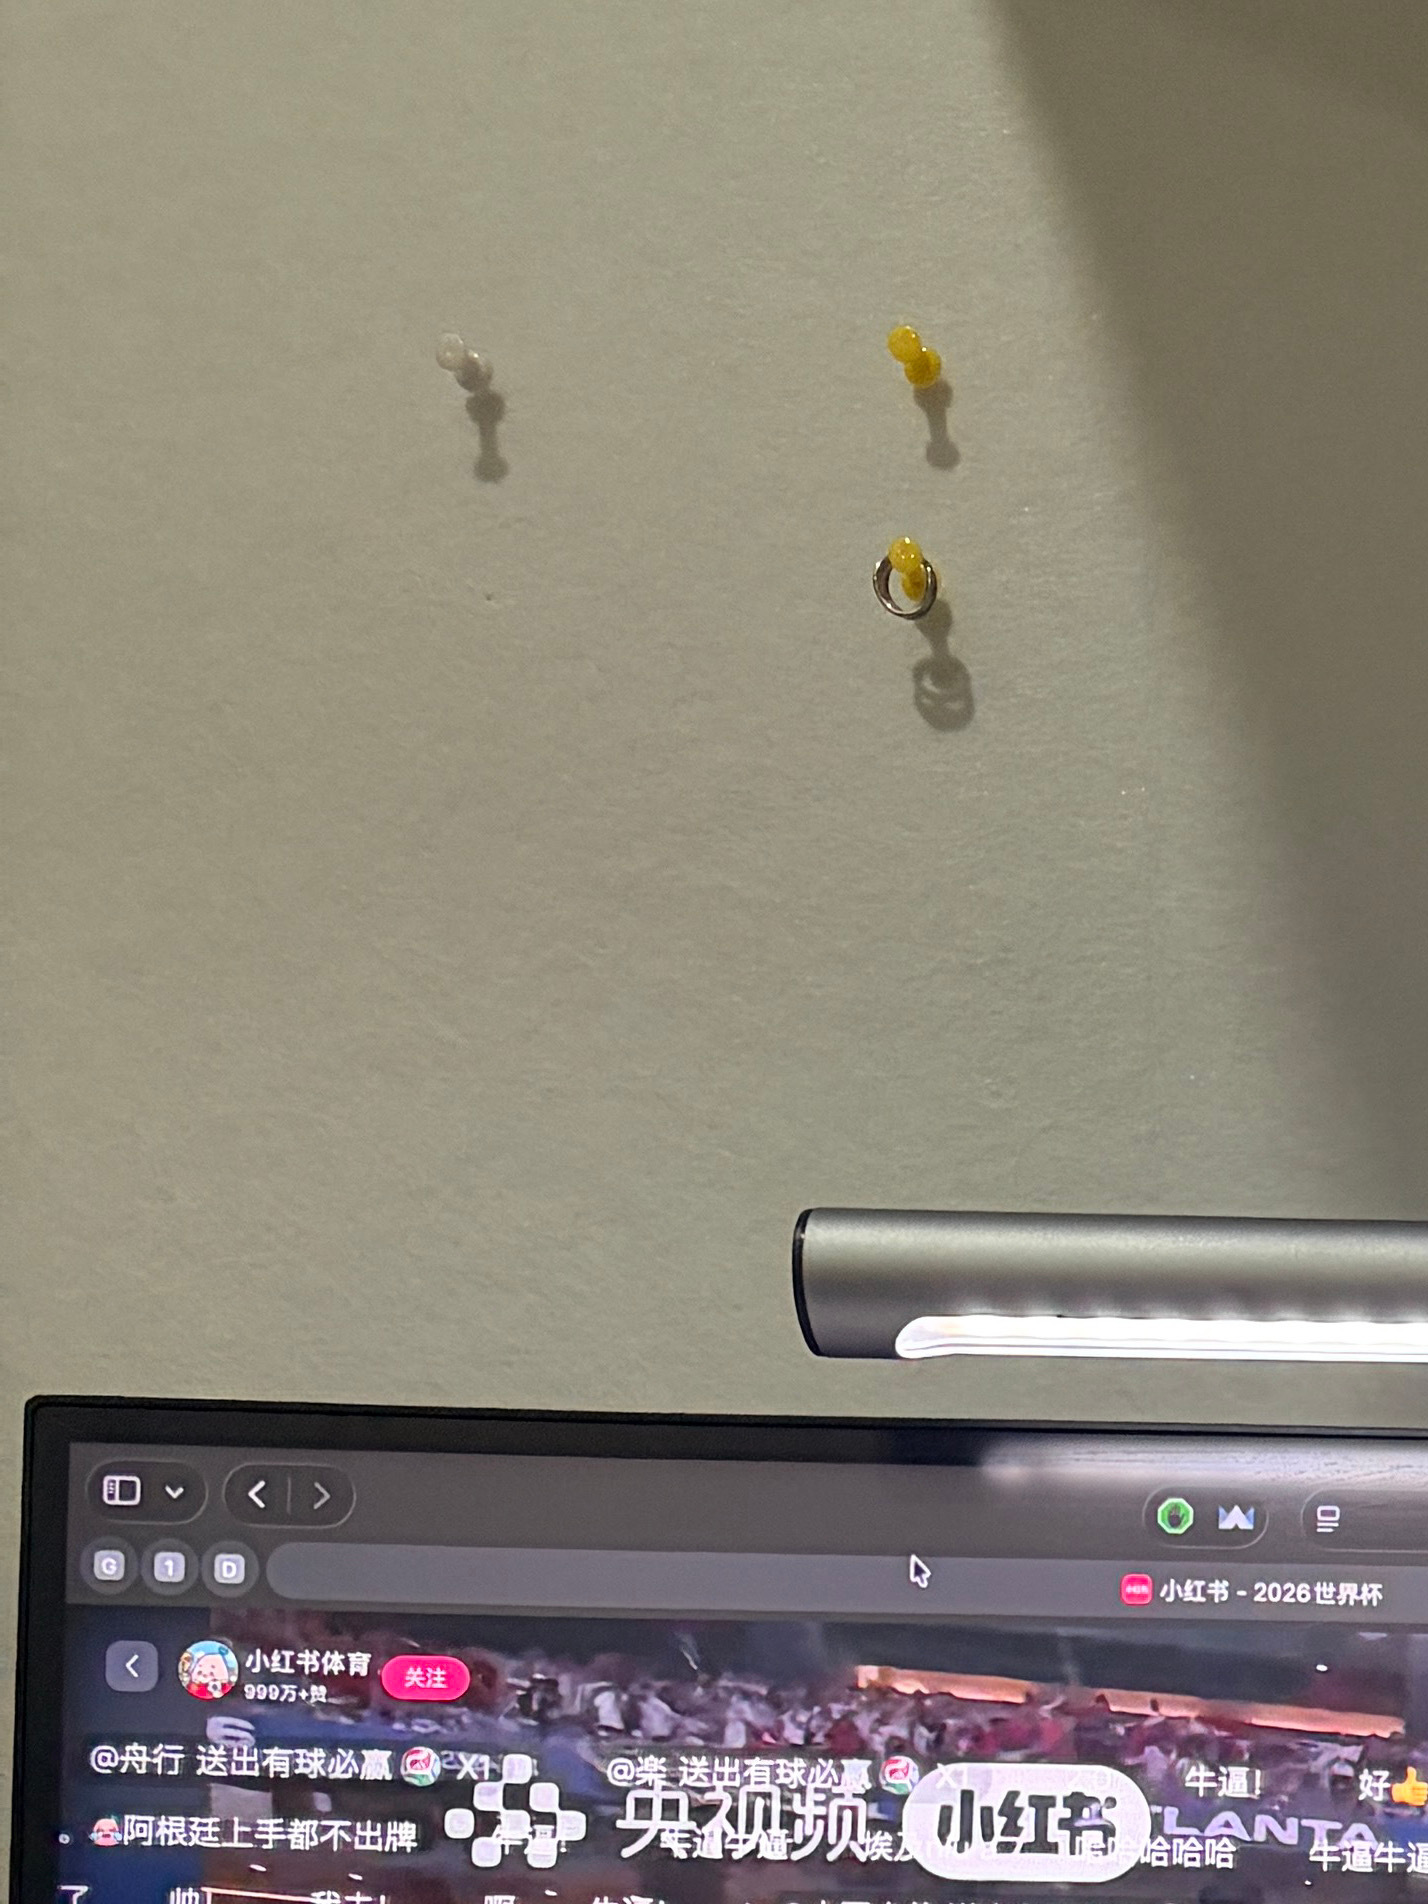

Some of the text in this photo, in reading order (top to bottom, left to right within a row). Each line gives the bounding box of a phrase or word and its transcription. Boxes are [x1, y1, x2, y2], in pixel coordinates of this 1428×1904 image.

[102, 1558, 117, 1576] G
[221, 1560, 238, 1578] D
[1159, 1578, 1229, 1604] 小红书
[1253, 1580, 1383, 1607] 2026世界杯
[244, 1650, 372, 1678] 小红书体育
[404, 1668, 448, 1690] 关注
[243, 1684, 328, 1704] 999万+赞
[89, 1744, 185, 1776] @舟行
[196, 1746, 393, 1781] 送出有球必赢
[1358, 1768, 1390, 1802] 好
[123, 1814, 418, 1853] 阿根廷上手都不出牌
